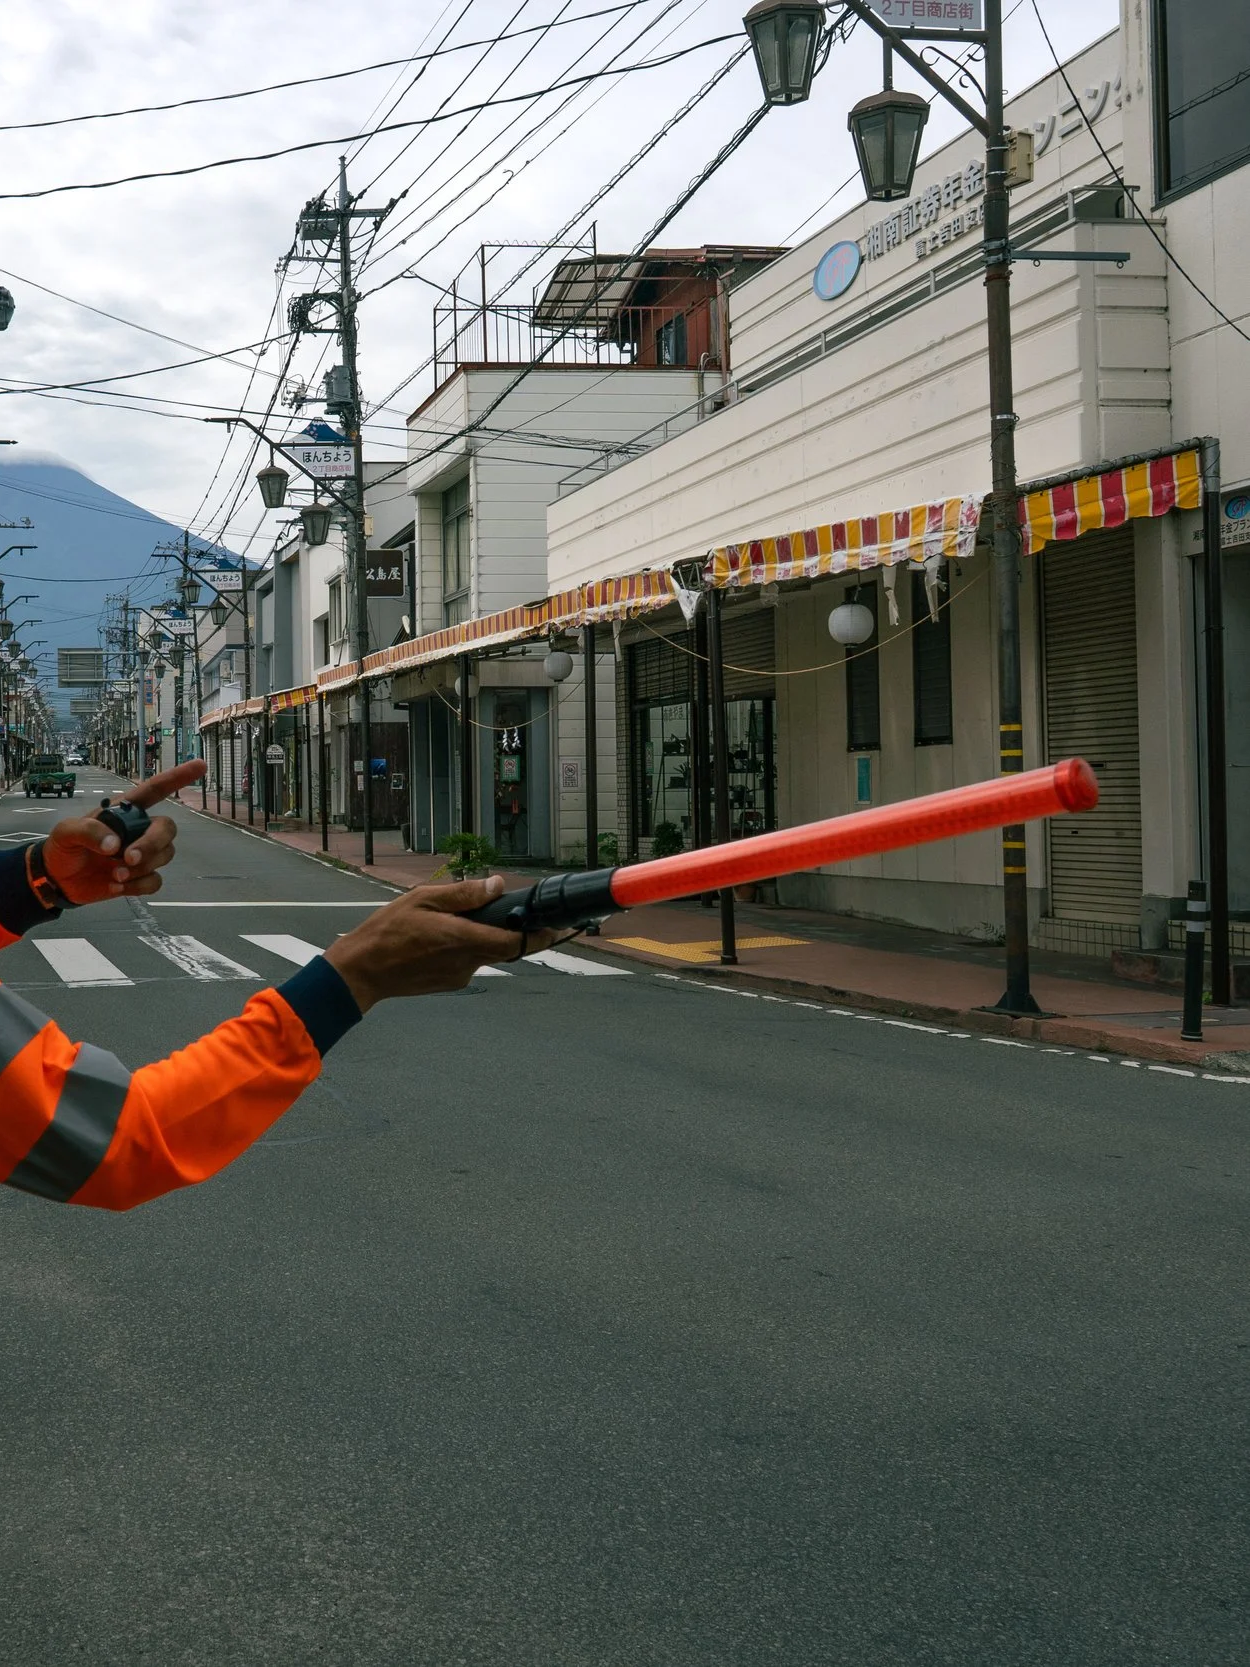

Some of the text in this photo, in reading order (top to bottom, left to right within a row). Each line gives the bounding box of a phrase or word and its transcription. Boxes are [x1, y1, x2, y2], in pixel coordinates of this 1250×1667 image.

[881, 0, 974, 20] 2丁目商店街
[302, 450, 352, 463] ほんちょう
[209, 574, 241, 582] ほんちょう
